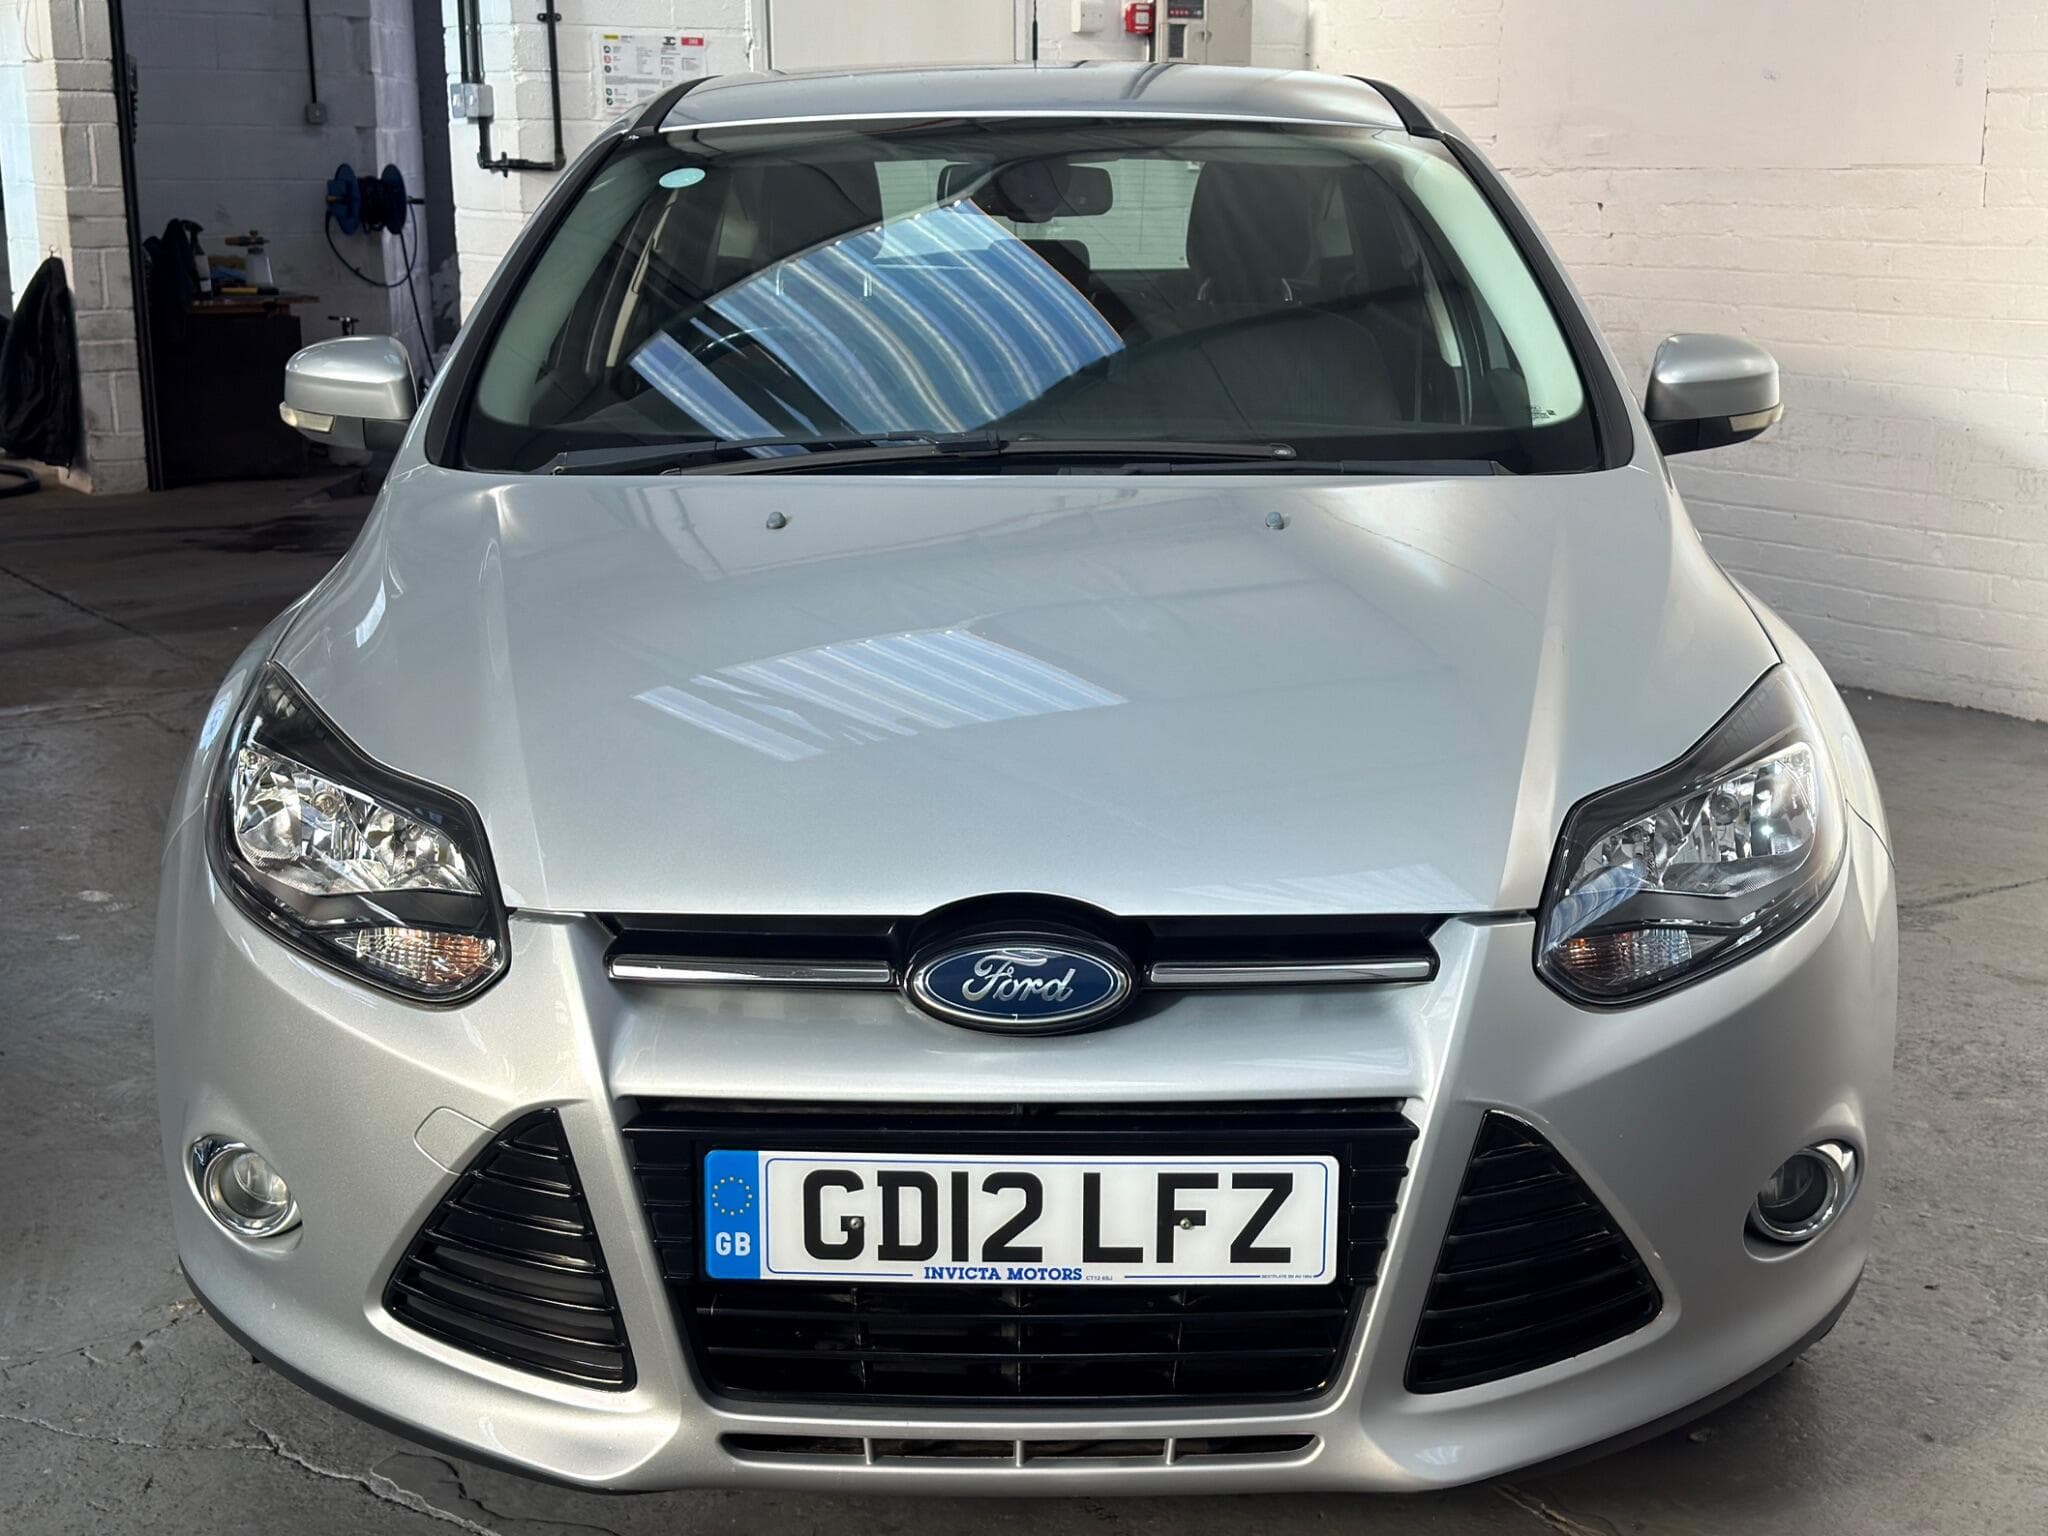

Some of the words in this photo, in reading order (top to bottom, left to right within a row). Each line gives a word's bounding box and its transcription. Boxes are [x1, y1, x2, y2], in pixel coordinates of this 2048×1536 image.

[962, 954, 1076, 1001] Ford
[803, 1169, 1043, 1262] GD12
[1082, 1172, 1294, 1263] LFZ
[715, 1231, 751, 1256] GB
[924, 1266, 1000, 1280] INVICTA
[1007, 1268, 1082, 1281] MOTORS
